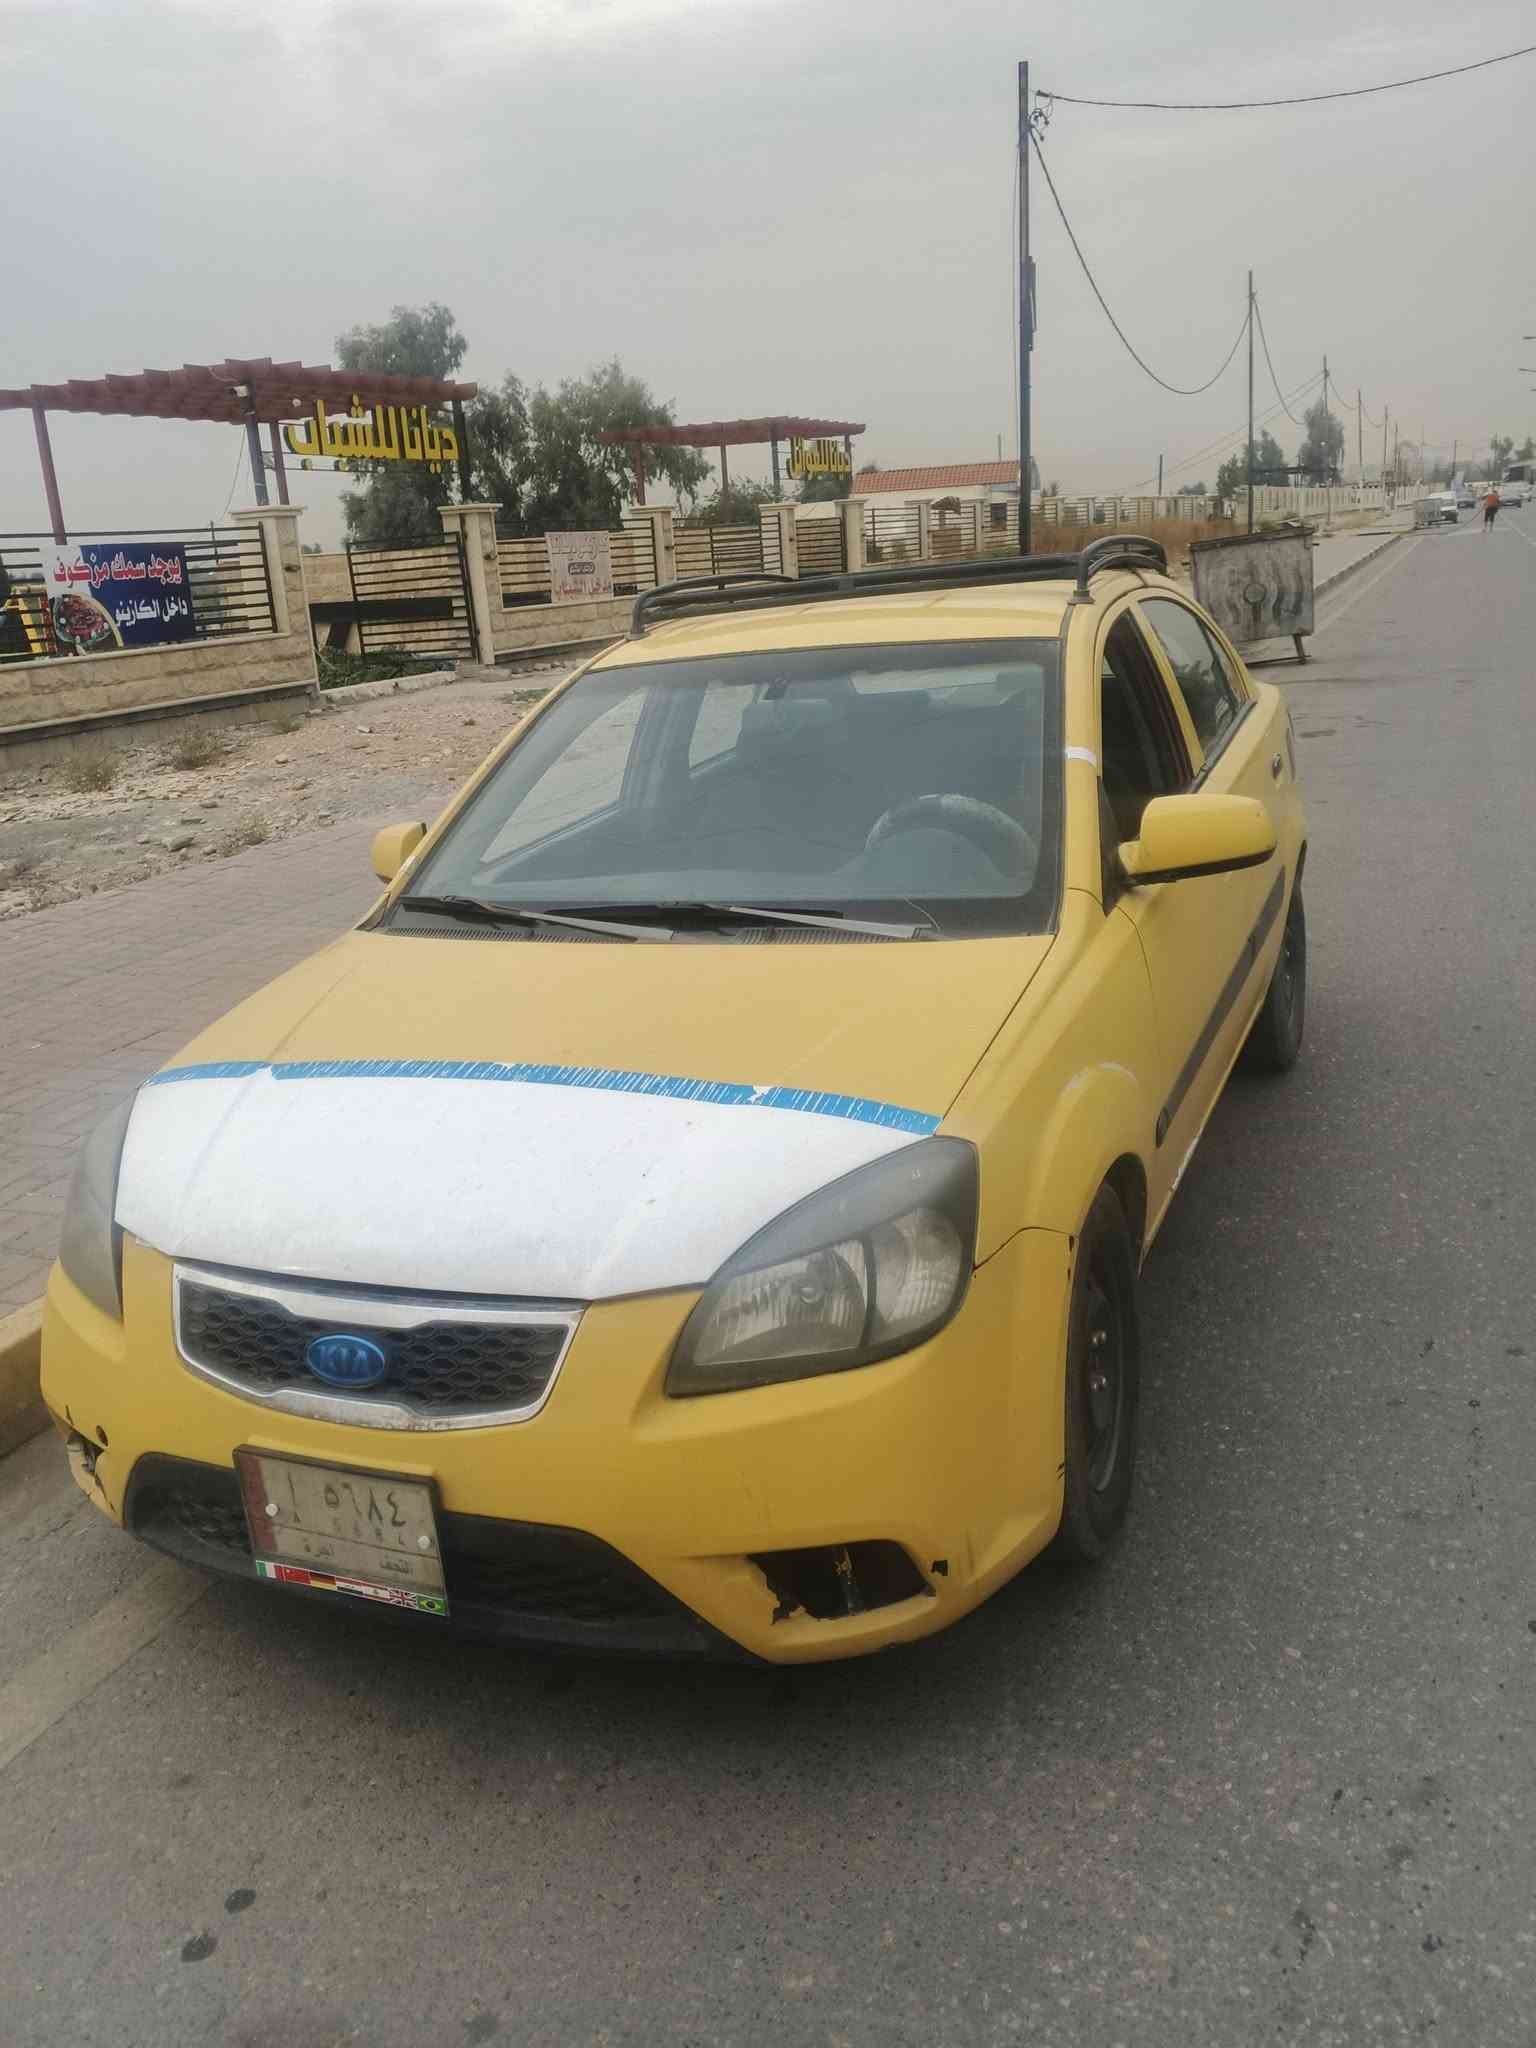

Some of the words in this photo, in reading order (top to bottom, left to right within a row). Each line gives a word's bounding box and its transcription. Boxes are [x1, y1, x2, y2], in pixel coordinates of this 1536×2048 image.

[285, 392, 401, 472] للشباب
[401, 405, 460, 475] ديانا
[54, 552, 110, 589] مزكوف
[111, 551, 146, 580] سمك
[148, 553, 182, 585] يوجد
[115, 598, 160, 627] الكازينو
[162, 595, 188, 622] داخل
